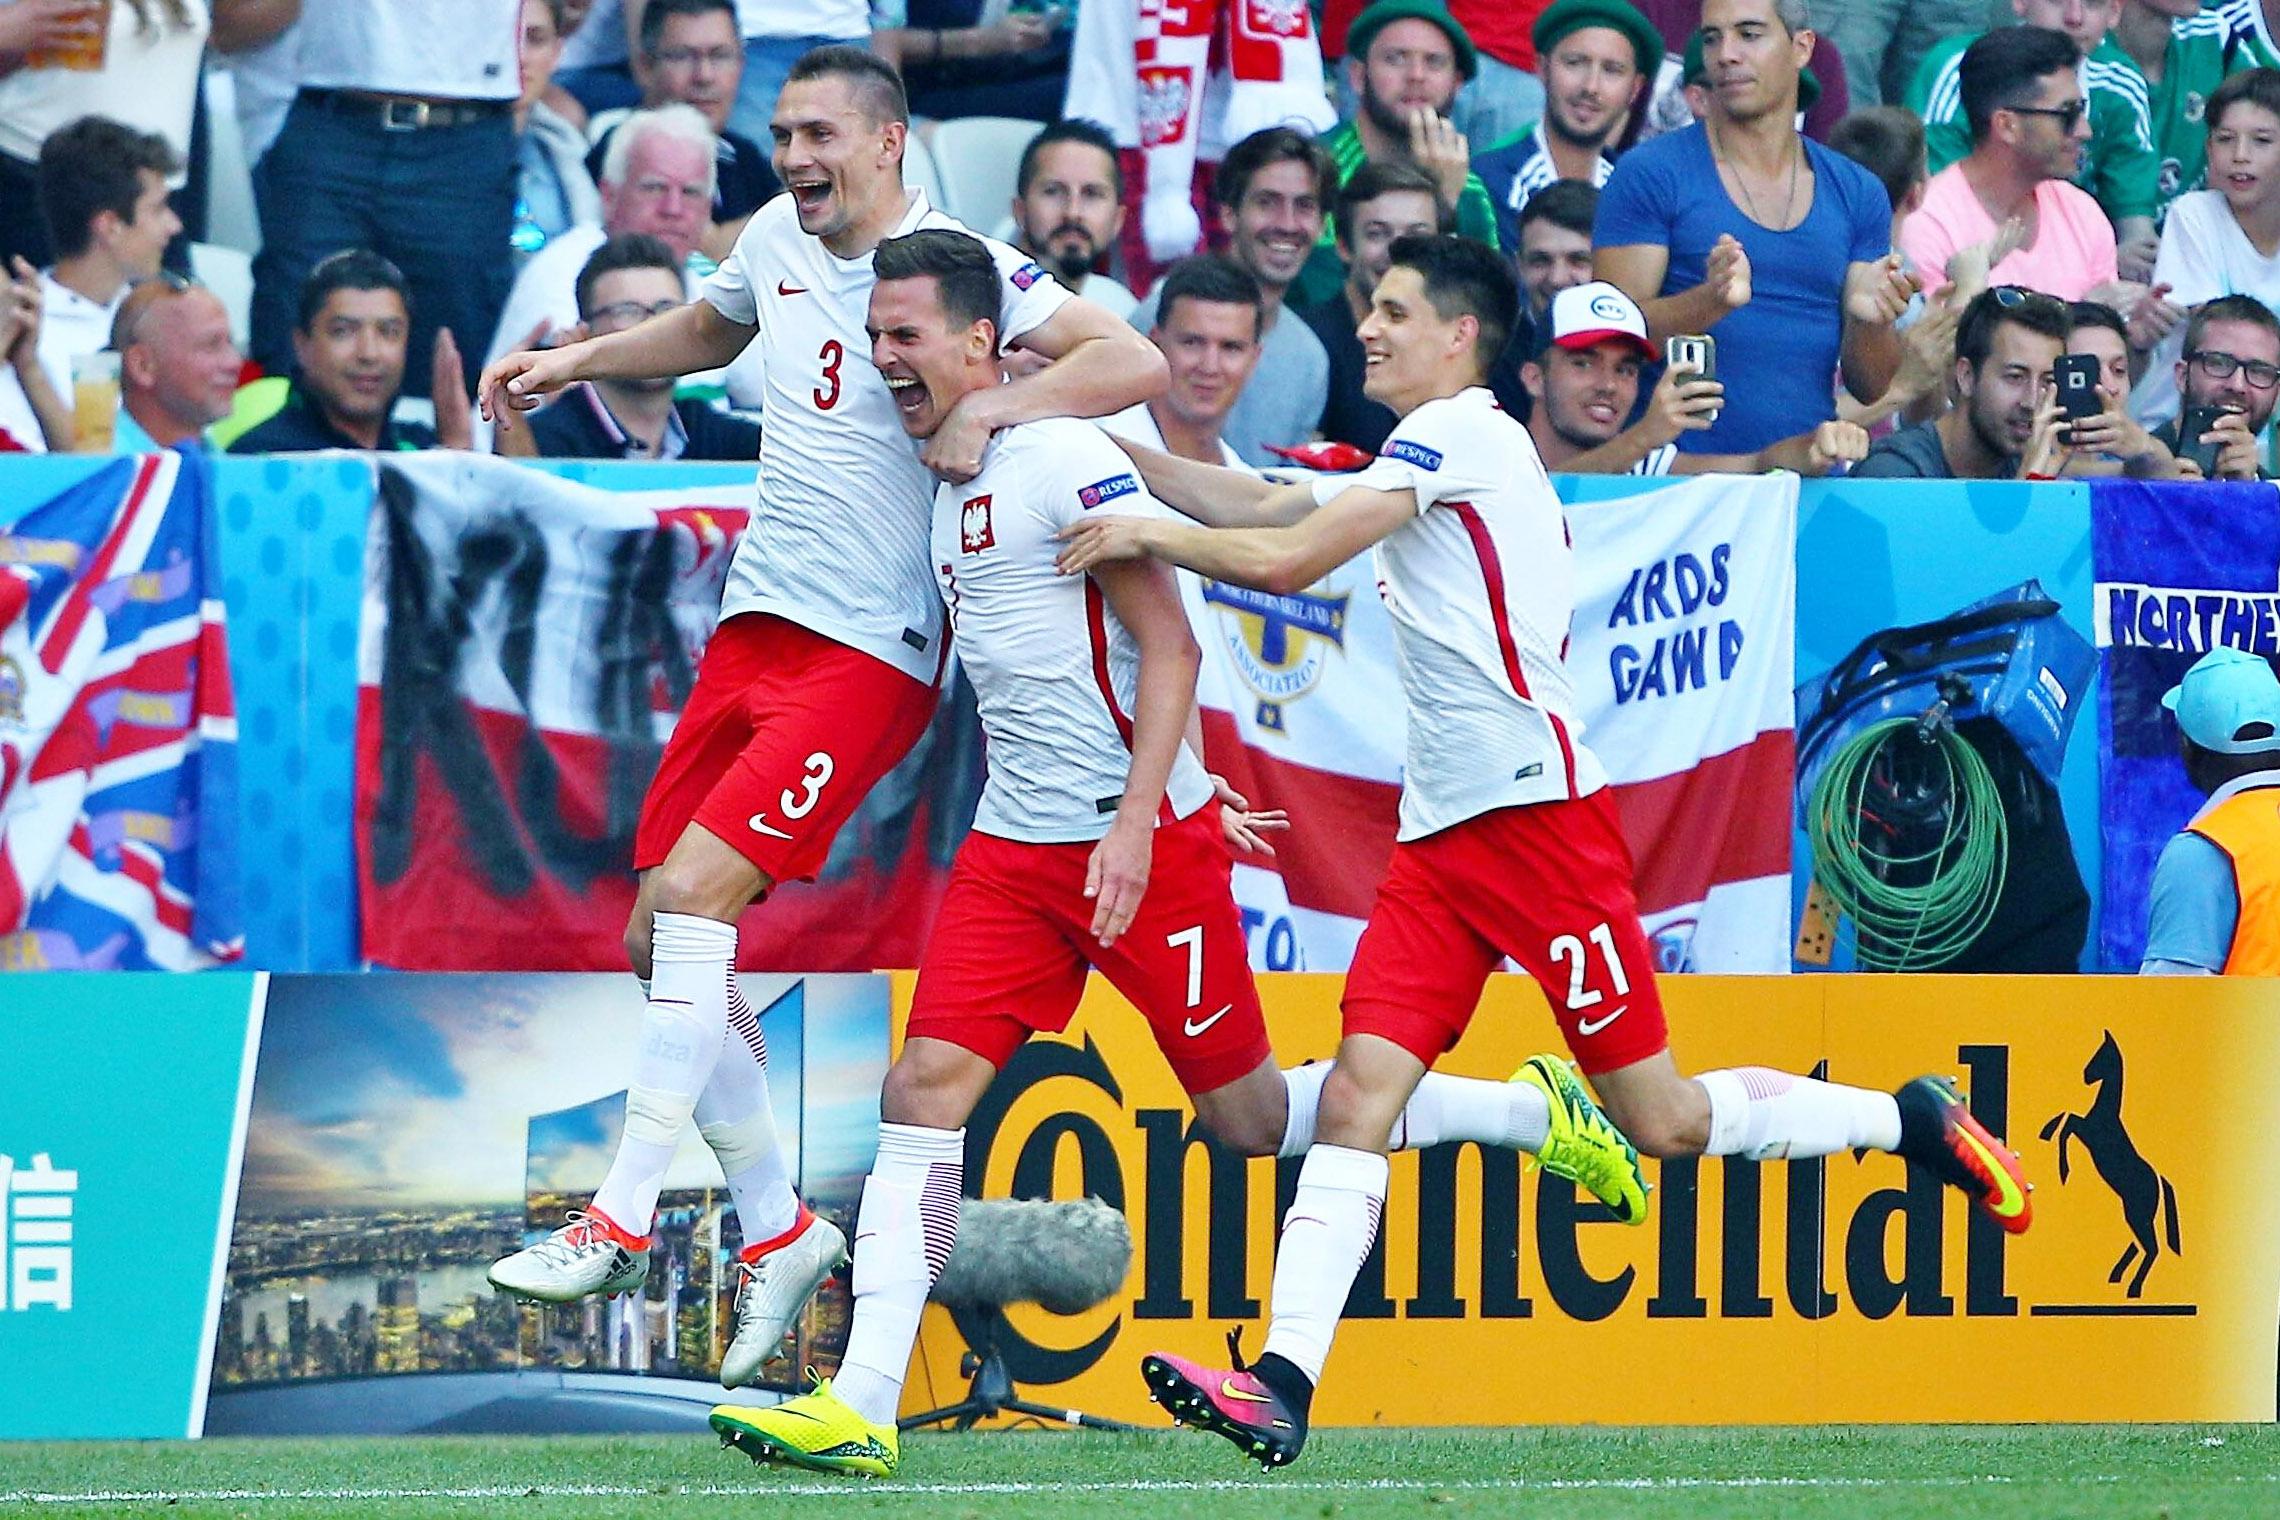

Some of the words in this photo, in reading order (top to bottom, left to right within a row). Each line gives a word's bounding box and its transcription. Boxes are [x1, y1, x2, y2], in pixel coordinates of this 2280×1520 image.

[814, 339, 842, 410] 3
[1098, 477, 1137, 498] RESPEC
[1609, 543, 1731, 629] ARDS
[2109, 588, 2280, 654] NORTHE
[780, 751, 834, 820] 3
[1166, 924, 1203, 1008] 7
[1549, 921, 1631, 1009] 21
[0, 1152, 78, 1312] 信
